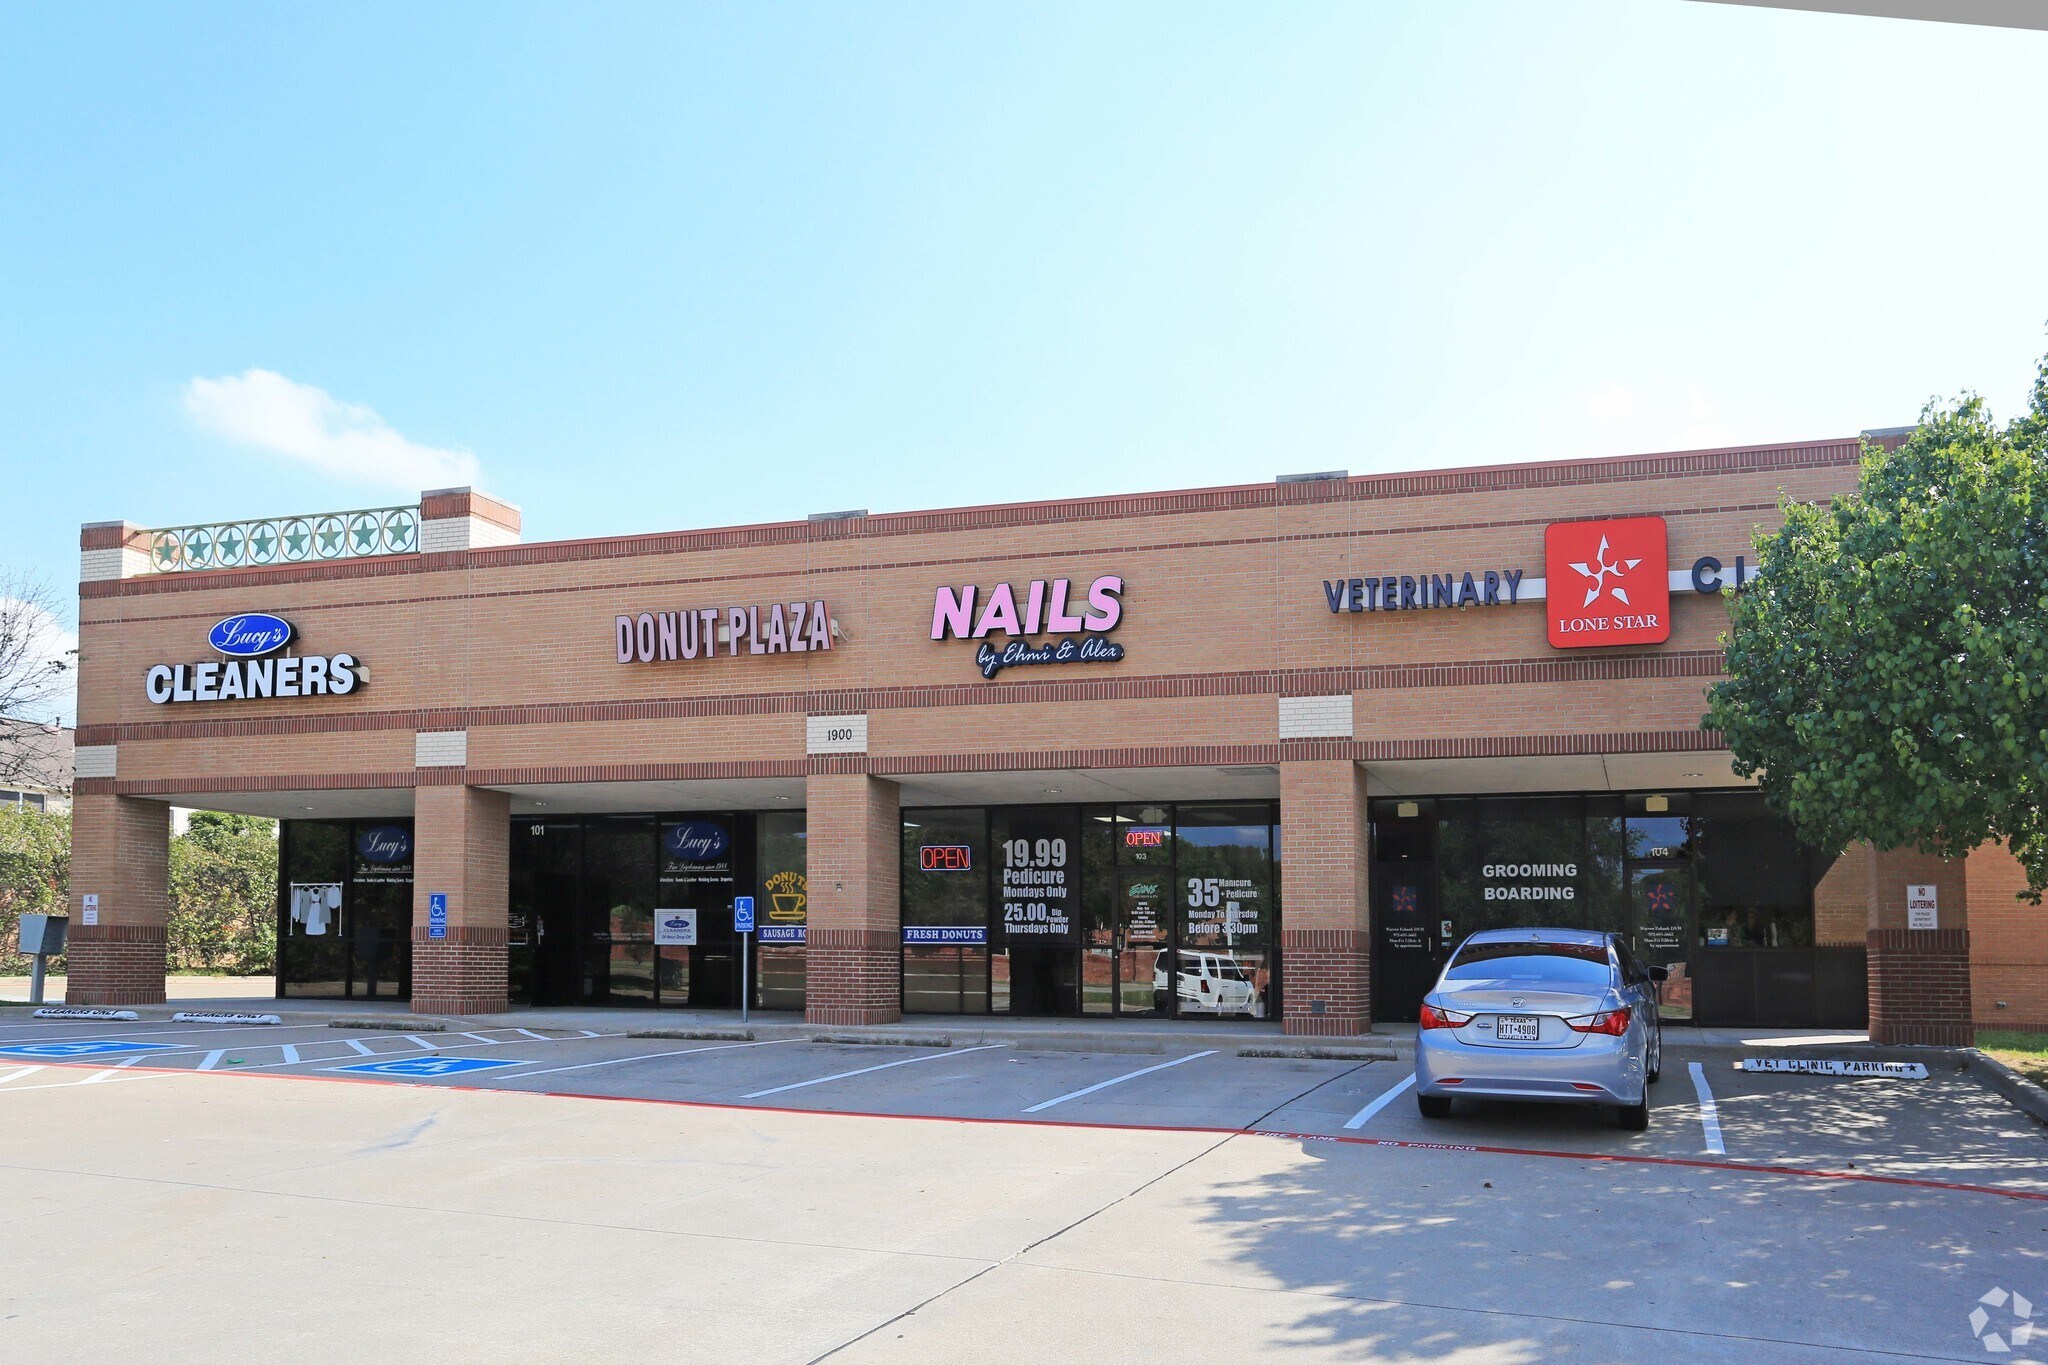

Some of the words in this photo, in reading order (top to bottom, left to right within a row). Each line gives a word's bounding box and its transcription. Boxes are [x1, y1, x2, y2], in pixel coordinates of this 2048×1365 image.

[1323, 569, 1523, 614] VETERINARY
[931, 575, 1123, 640] NAILS
[1560, 617, 1610, 633] LONE
[1613, 614, 1659, 630] STAR
[216, 618, 284, 651] Lucy's
[615, 608, 719, 664] DONUT
[728, 600, 831, 656] PLAZA
[978, 644, 997, 675] by
[1003, 642, 1050, 663] Ehmi
[1056, 641, 1074, 659] &
[1080, 638, 1117, 659] Alex
[146, 653, 354, 704] CLEANERS
[827, 728, 852, 741] 1900
[530, 825, 544, 836] 101
[366, 831, 407, 859] Lucy's
[673, 827, 720, 857] Lucy's
[1126, 831, 1161, 846] OPEN
[922, 848, 968, 868] OPEN
[1002, 838, 1067, 868] 19.99
[1003, 868, 1065, 885] Pedicure
[1482, 864, 1578, 877] GROOMING
[1219, 879, 1252, 887] Manicure
[1003, 886, 1045, 898] Mondays
[1046, 886, 1067, 898] Only
[1187, 878, 1220, 907] 35
[1226, 889, 1258, 898] Pedicure
[1484, 886, 1575, 900] BOARDING
[1918, 887, 1926, 896] NO
[1910, 900, 1935, 909] LOITERING
[1004, 903, 1047, 921] 25.00
[1051, 908, 1062, 917] Dip
[1188, 910, 1215, 919] Monday
[1216, 910, 1225, 918] To
[763, 929, 795, 938] SAUSAGE
[906, 930, 940, 939] FRESH
[942, 929, 983, 939] DONUTS
[1005, 923, 1049, 934] Thursdays
[1049, 923, 1069, 934] Only
[1189, 922, 1220, 934] Before
[1755, 1059, 1780, 1068] VET
[1788, 1060, 1833, 1070] CLINIC
[1843, 1061, 1903, 1073] PARKING
[1297, 1134, 1339, 1142] LANE
[1407, 1143, 1477, 1151] PARKING
